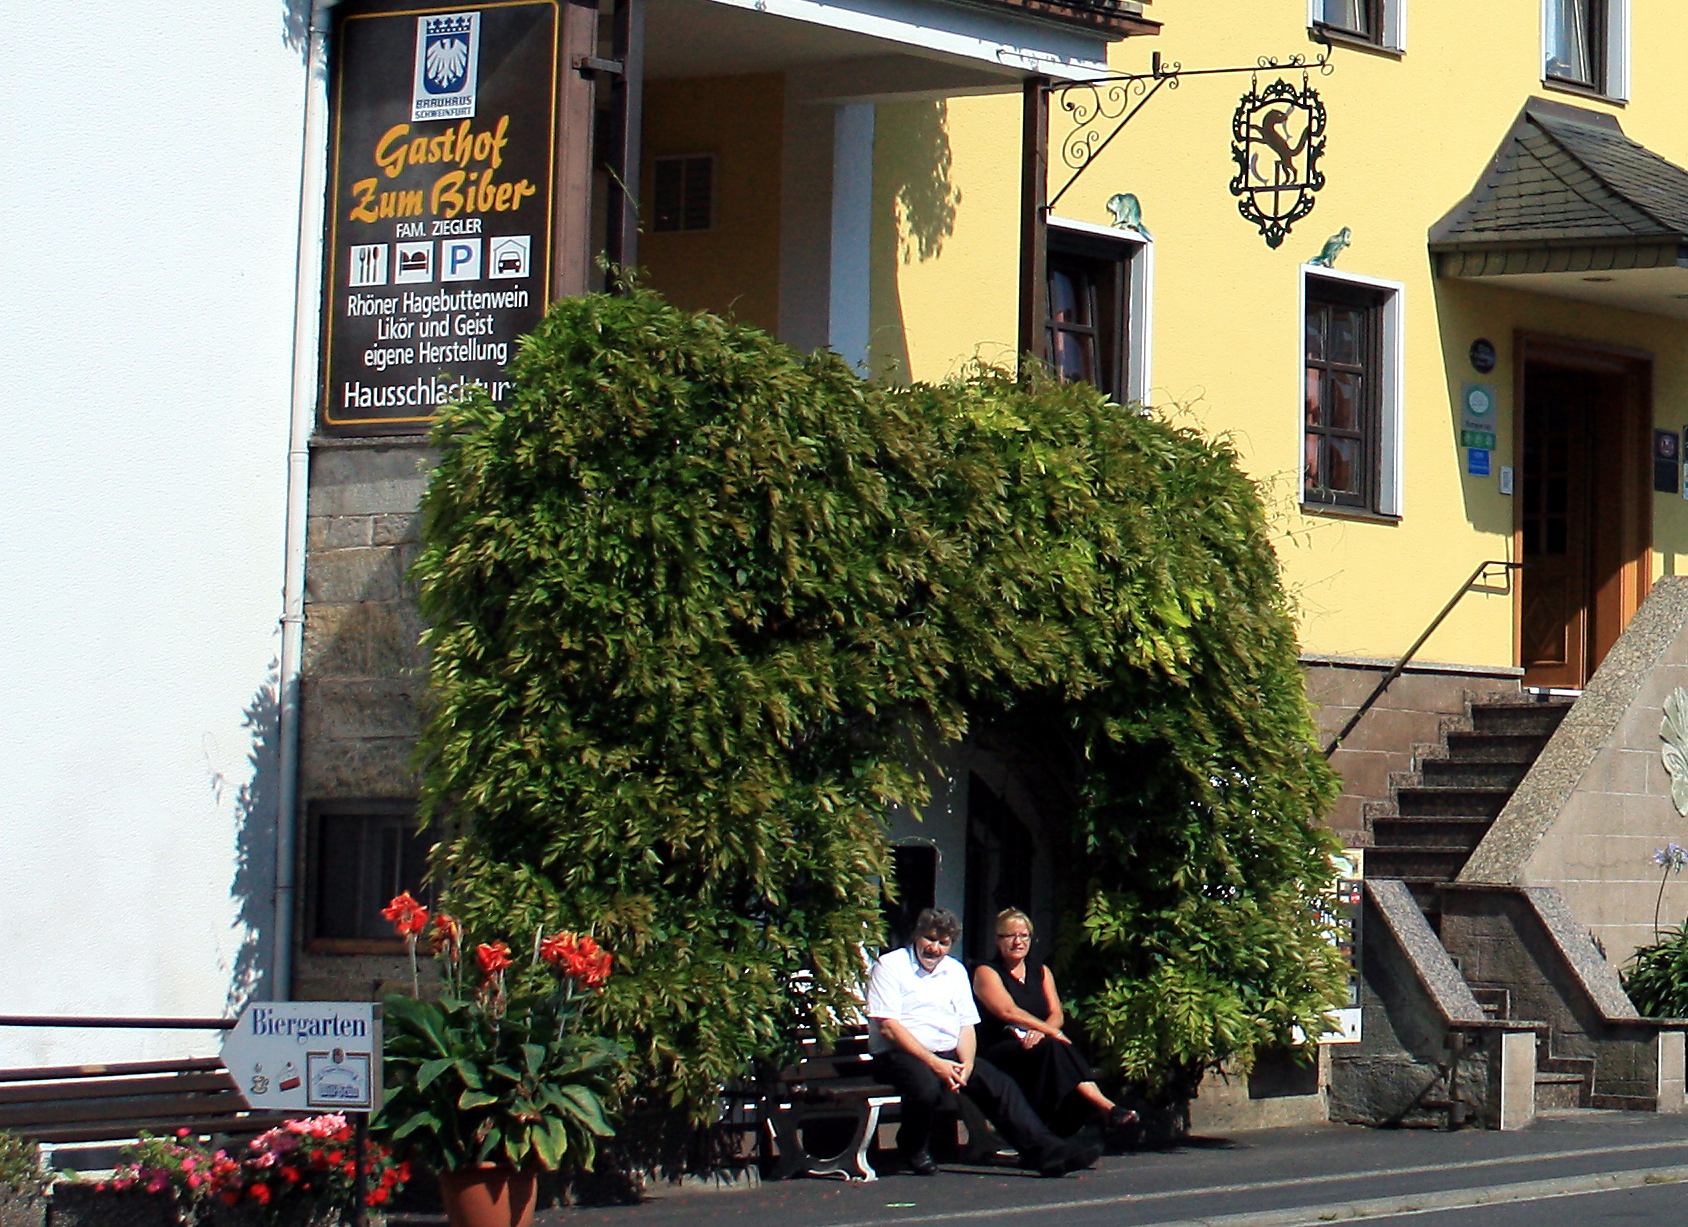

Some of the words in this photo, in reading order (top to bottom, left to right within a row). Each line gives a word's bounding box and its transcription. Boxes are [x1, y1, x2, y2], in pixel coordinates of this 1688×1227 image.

[415, 96, 473, 109] BRAUHAUS
[375, 114, 509, 178] Gasthof
[349, 177, 424, 223] Zum
[430, 168, 536, 219] Biber
[396, 222, 426, 238] FAM.
[432, 219, 482, 236] ZIEGLER
[347, 294, 399, 316] Rhöner
[402, 284, 528, 318] Hagebuttenwein
[378, 317, 415, 341] Likör
[419, 314, 450, 338] und
[454, 312, 494, 336] Geist
[364, 343, 414, 371] eigene
[419, 337, 508, 365] Herstellung
[252, 1007, 366, 1045] Biergarten
